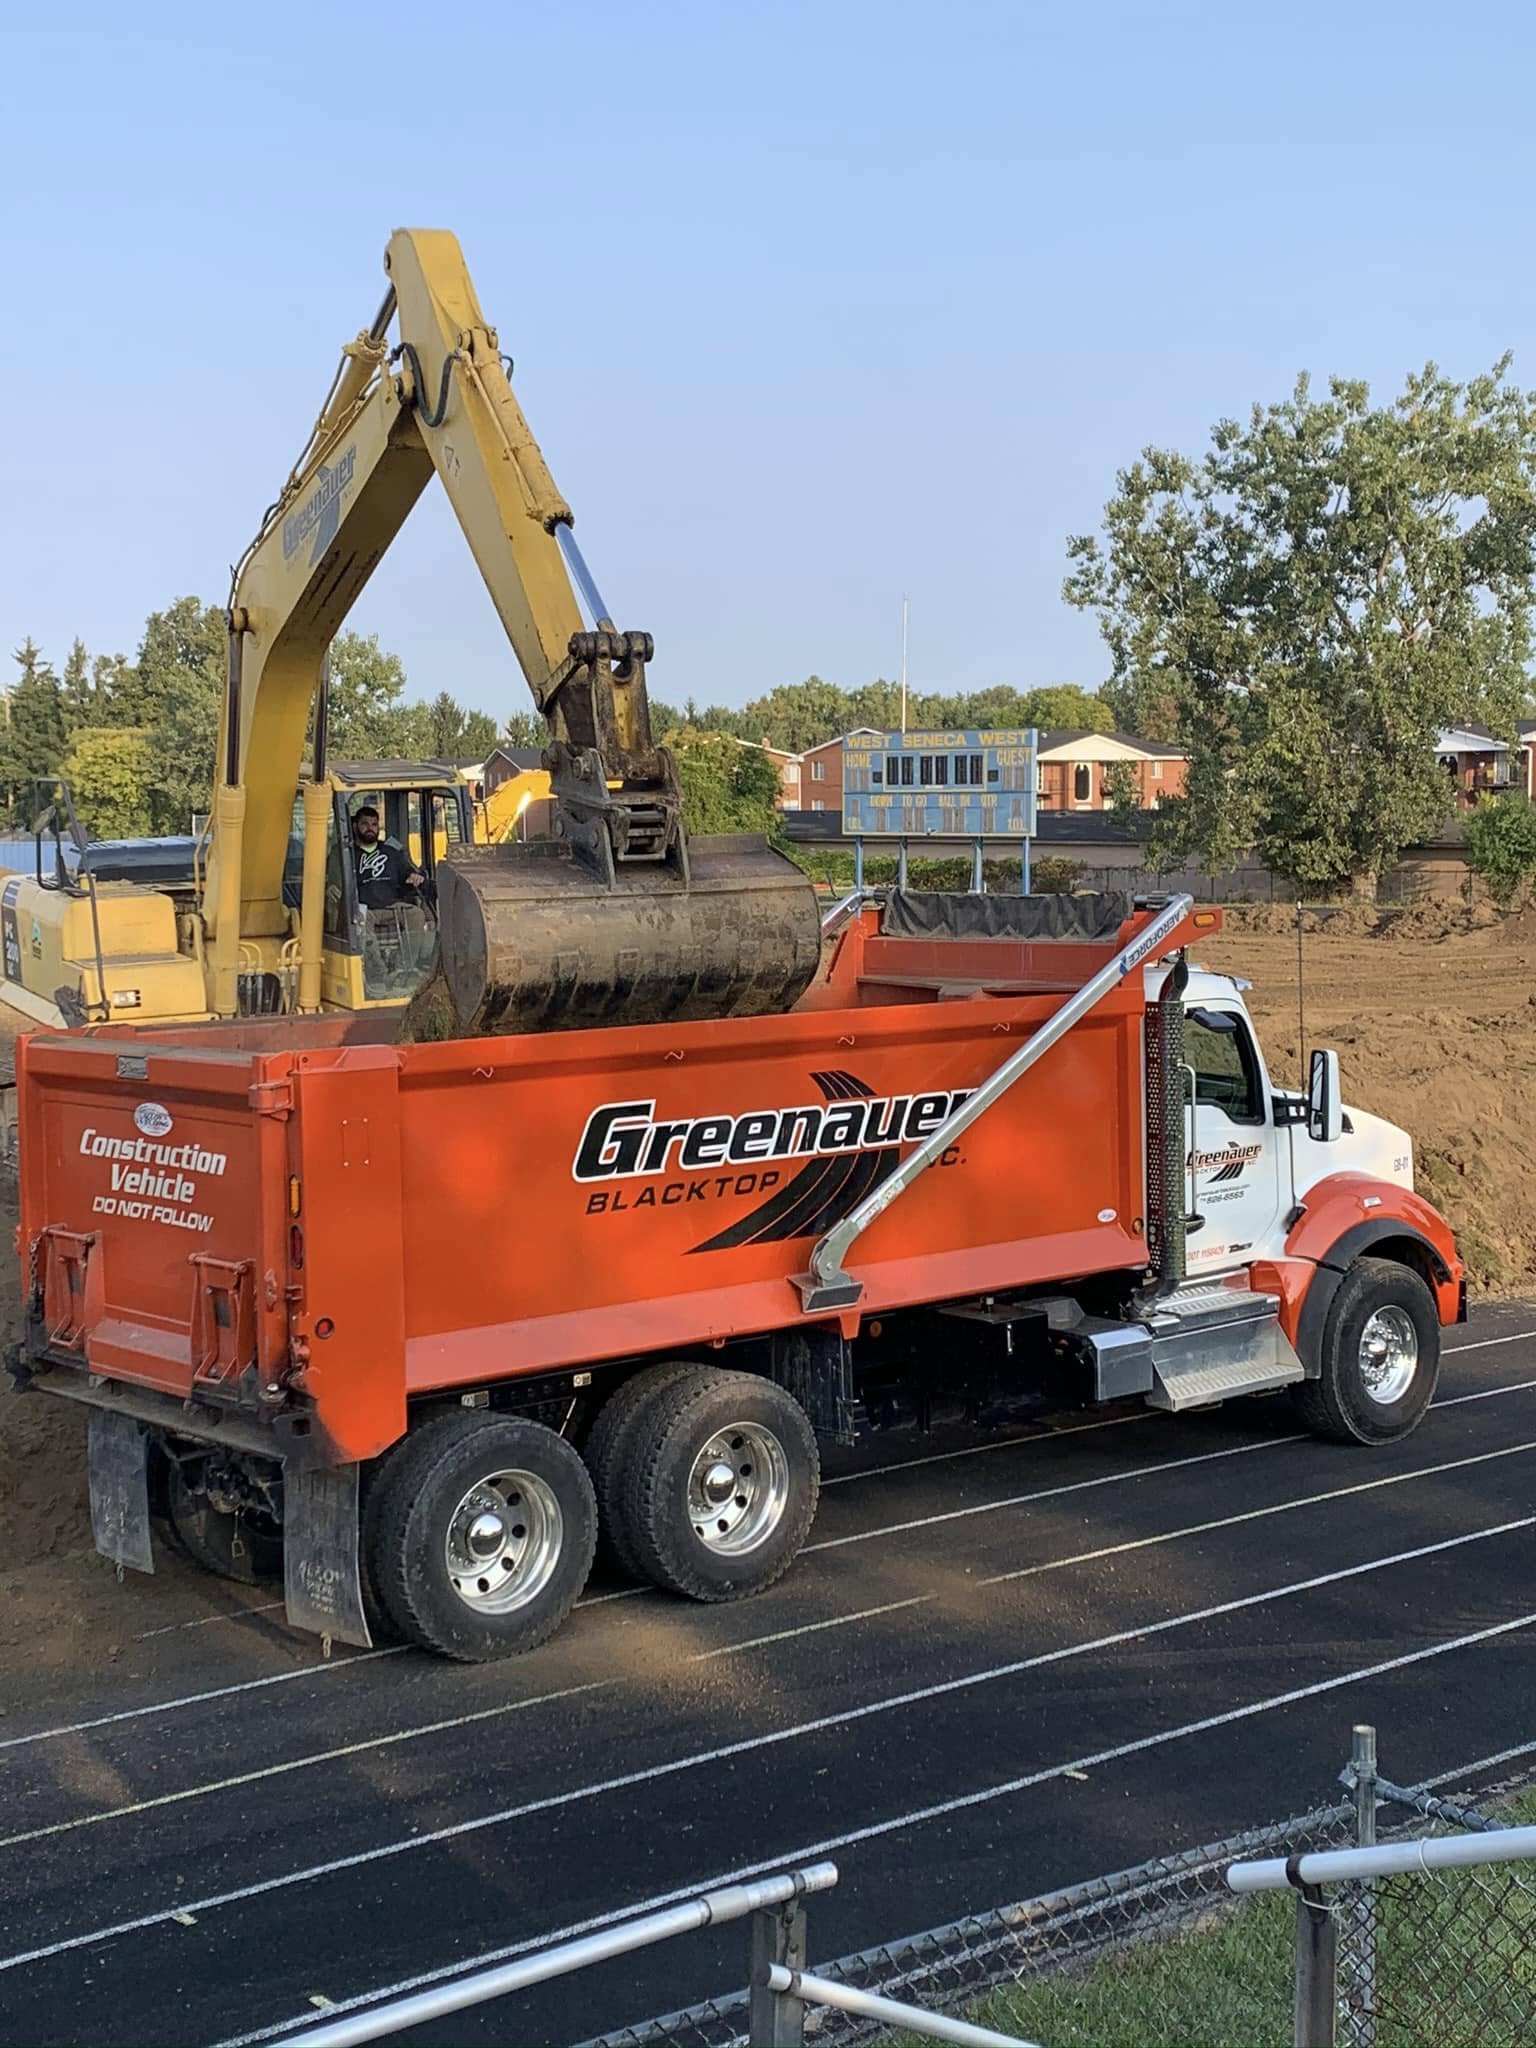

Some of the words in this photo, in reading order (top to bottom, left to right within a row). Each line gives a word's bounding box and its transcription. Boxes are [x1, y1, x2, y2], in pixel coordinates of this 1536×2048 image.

[846, 735, 892, 748] WEST
[903, 733, 967, 748] SENECA
[979, 730, 1029, 746] WEST
[1129, 911, 1181, 966] AEROFORCE
[80, 1128, 227, 1176] Construction
[111, 1163, 195, 1204] Vehicle
[586, 1171, 780, 1215] BLACKTOP
[92, 1196, 117, 1214] DO
[117, 1200, 152, 1220] NOT
[151, 1206, 215, 1232] FOLLOW
